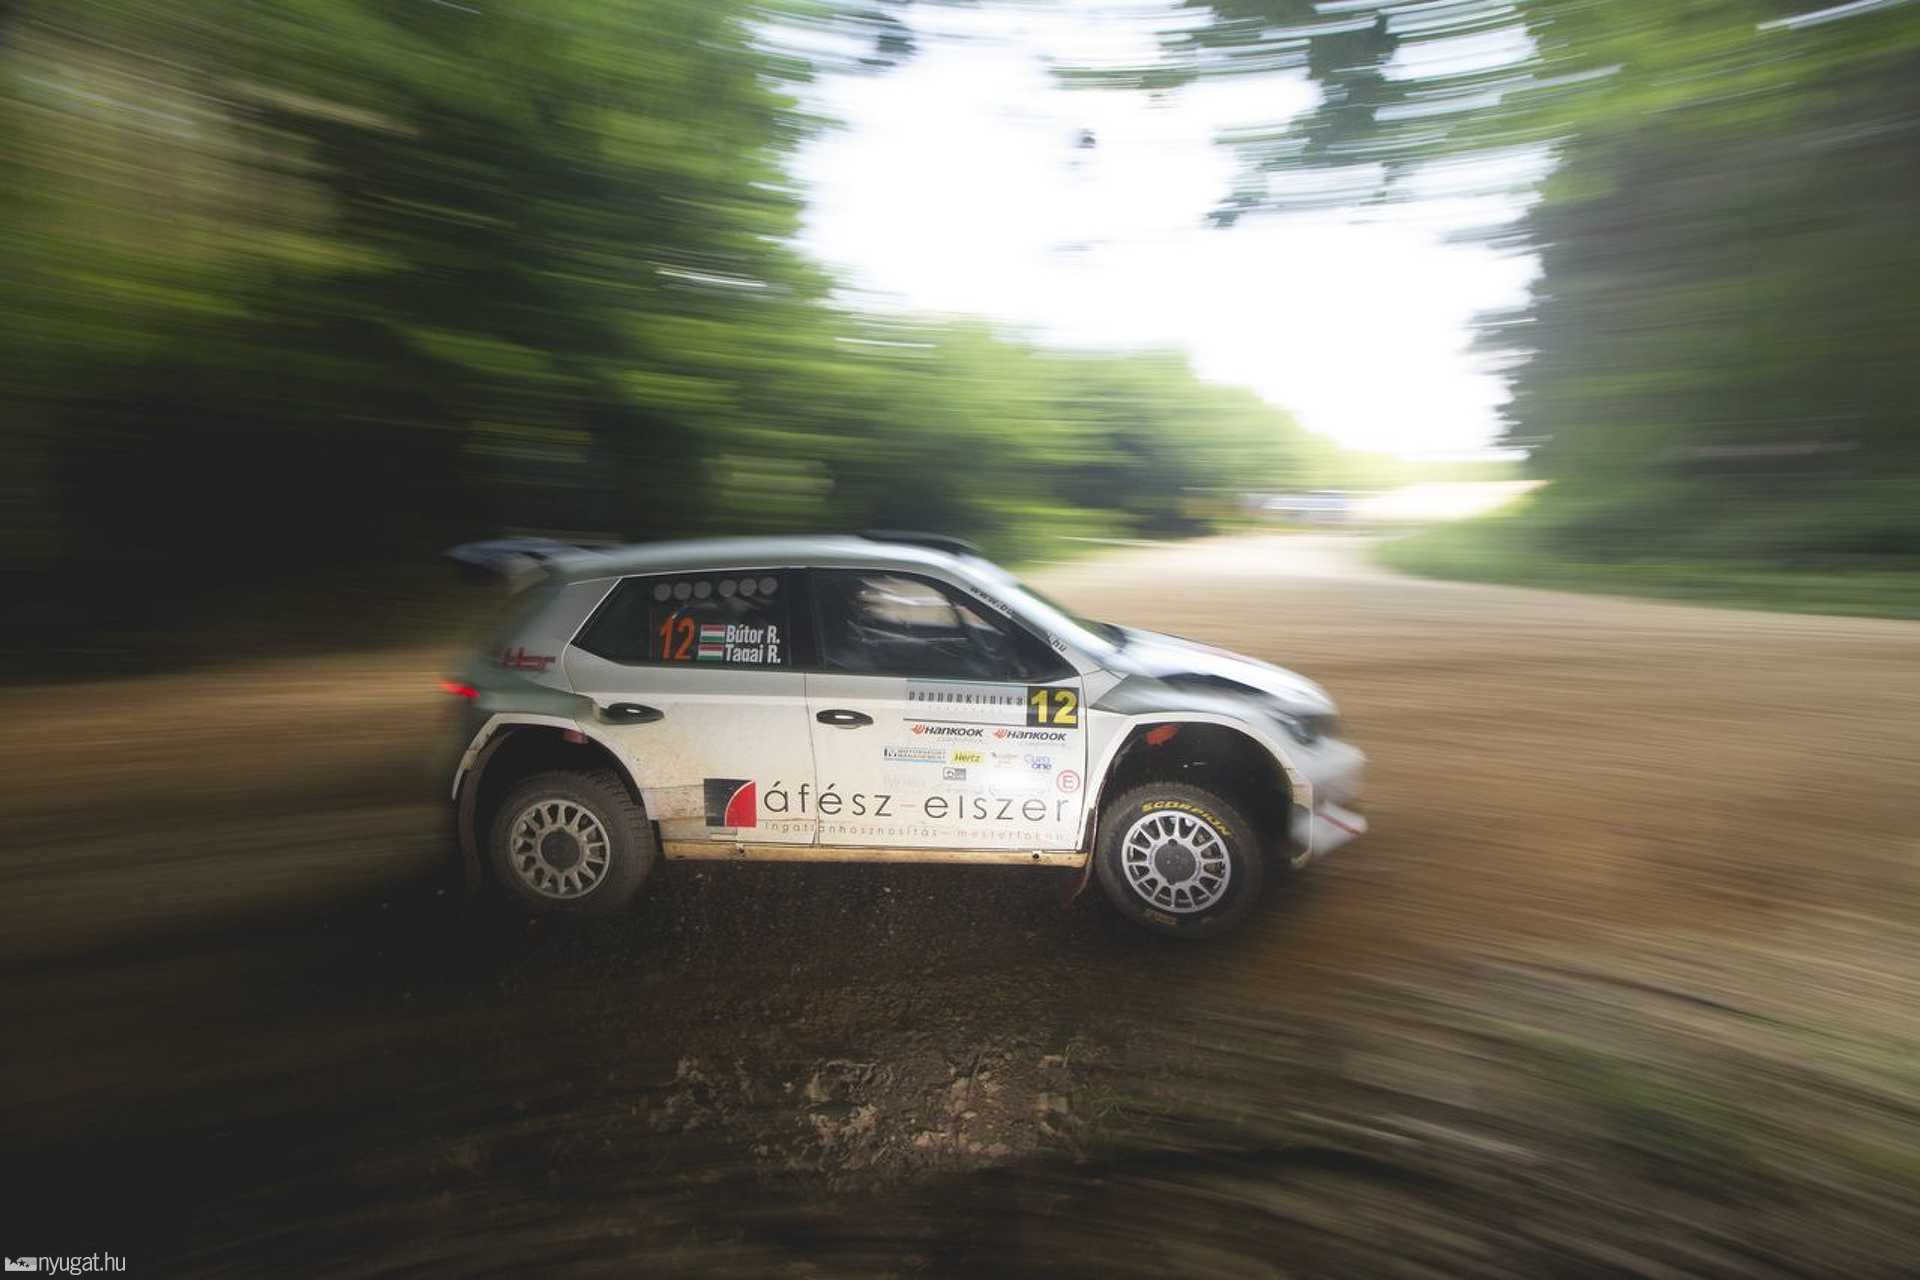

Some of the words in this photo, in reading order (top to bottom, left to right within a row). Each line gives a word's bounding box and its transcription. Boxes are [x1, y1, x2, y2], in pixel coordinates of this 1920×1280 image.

[660, 613, 695, 659] 12
[726, 624, 764, 643] Bútor
[766, 624, 780, 644] R.
[767, 644, 781, 664] R.
[1031, 689, 1079, 725] 12
[954, 752, 981, 764] Hertz
[1141, 800, 1233, 837] SCORPION
